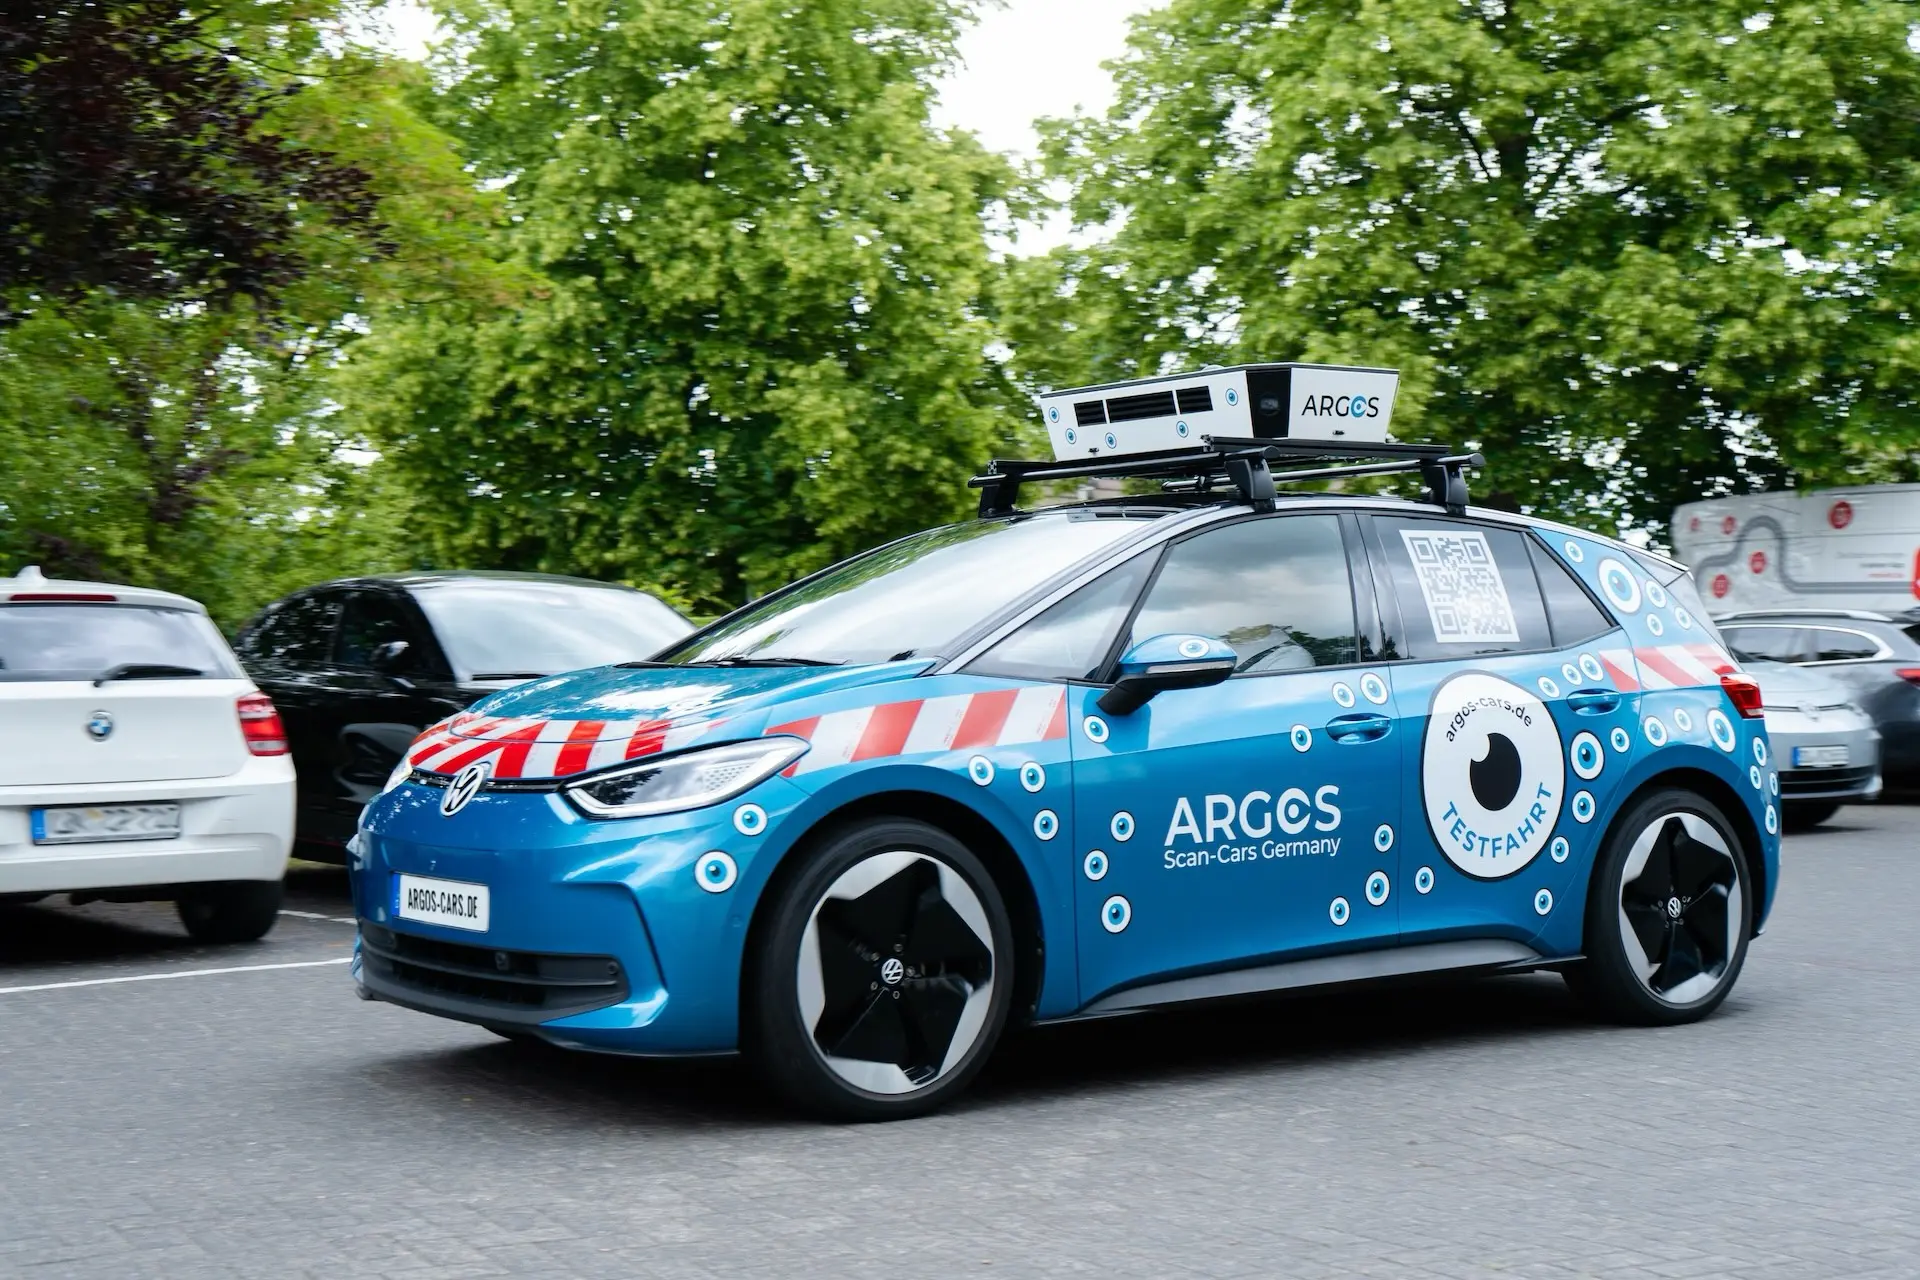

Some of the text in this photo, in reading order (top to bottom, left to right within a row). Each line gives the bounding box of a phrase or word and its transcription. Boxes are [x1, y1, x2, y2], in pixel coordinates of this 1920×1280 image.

[1301, 394, 1380, 418] ARGOS
[1445, 697, 1532, 742] argos-cars.de
[1164, 784, 1342, 847] ARGOS
[1442, 782, 1552, 858] TESTFAHRT
[1163, 838, 1341, 869] Scan-Cars Germany
[407, 887, 478, 919] ARGOS-CARS.DE
